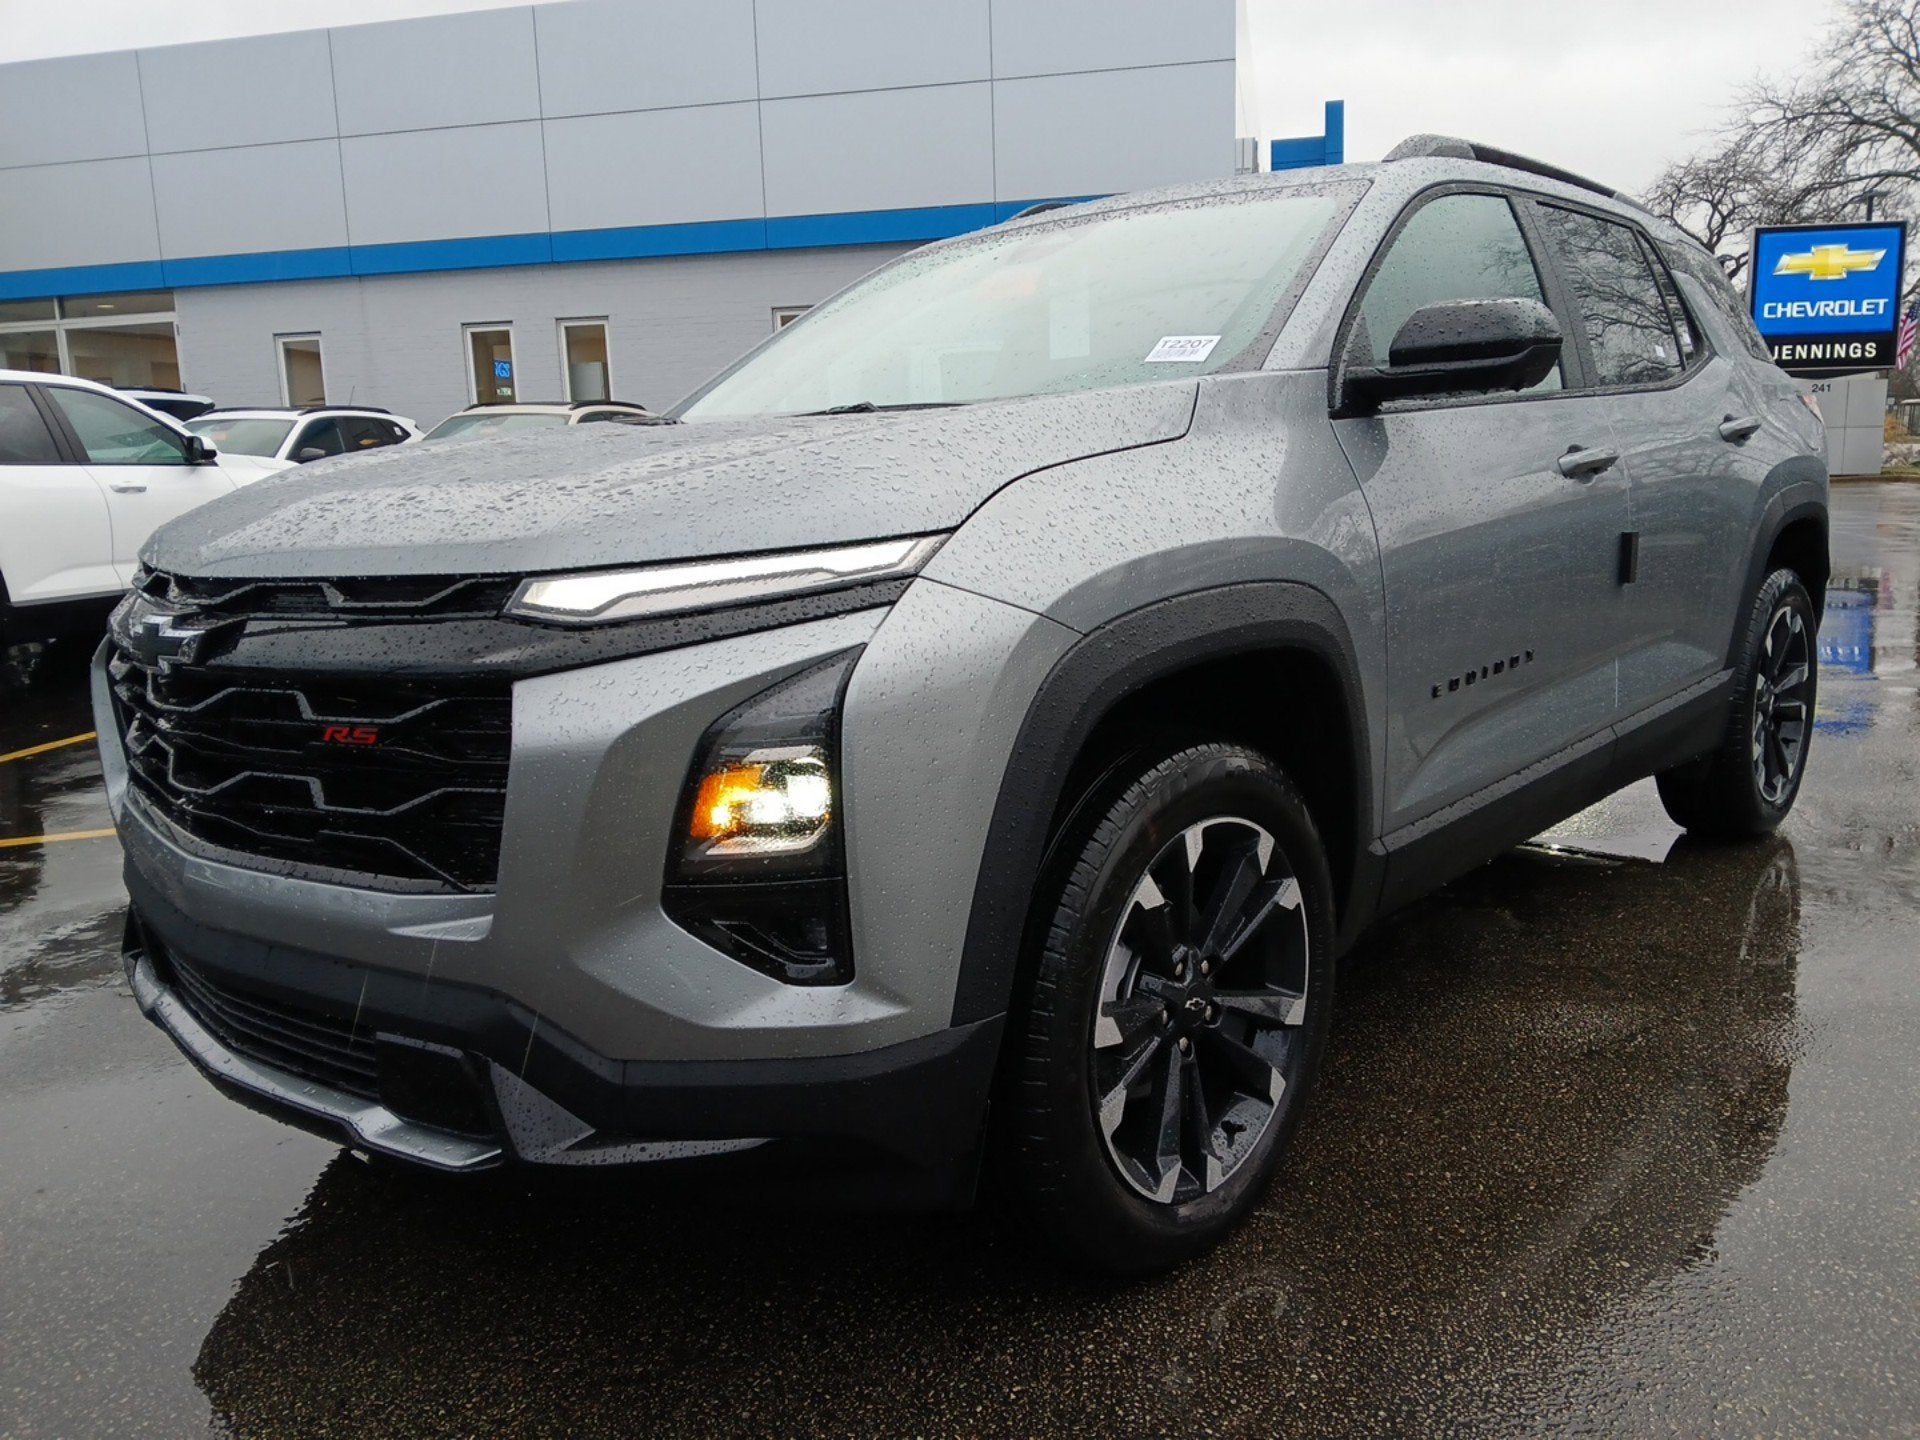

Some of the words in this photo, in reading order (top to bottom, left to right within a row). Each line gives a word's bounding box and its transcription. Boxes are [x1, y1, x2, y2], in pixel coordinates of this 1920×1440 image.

[1763, 298, 1889, 319] CHEVROLET
[1772, 342, 1877, 360] JENNINGS
[1811, 383, 1832, 393] 241
[323, 726, 379, 745] RS
